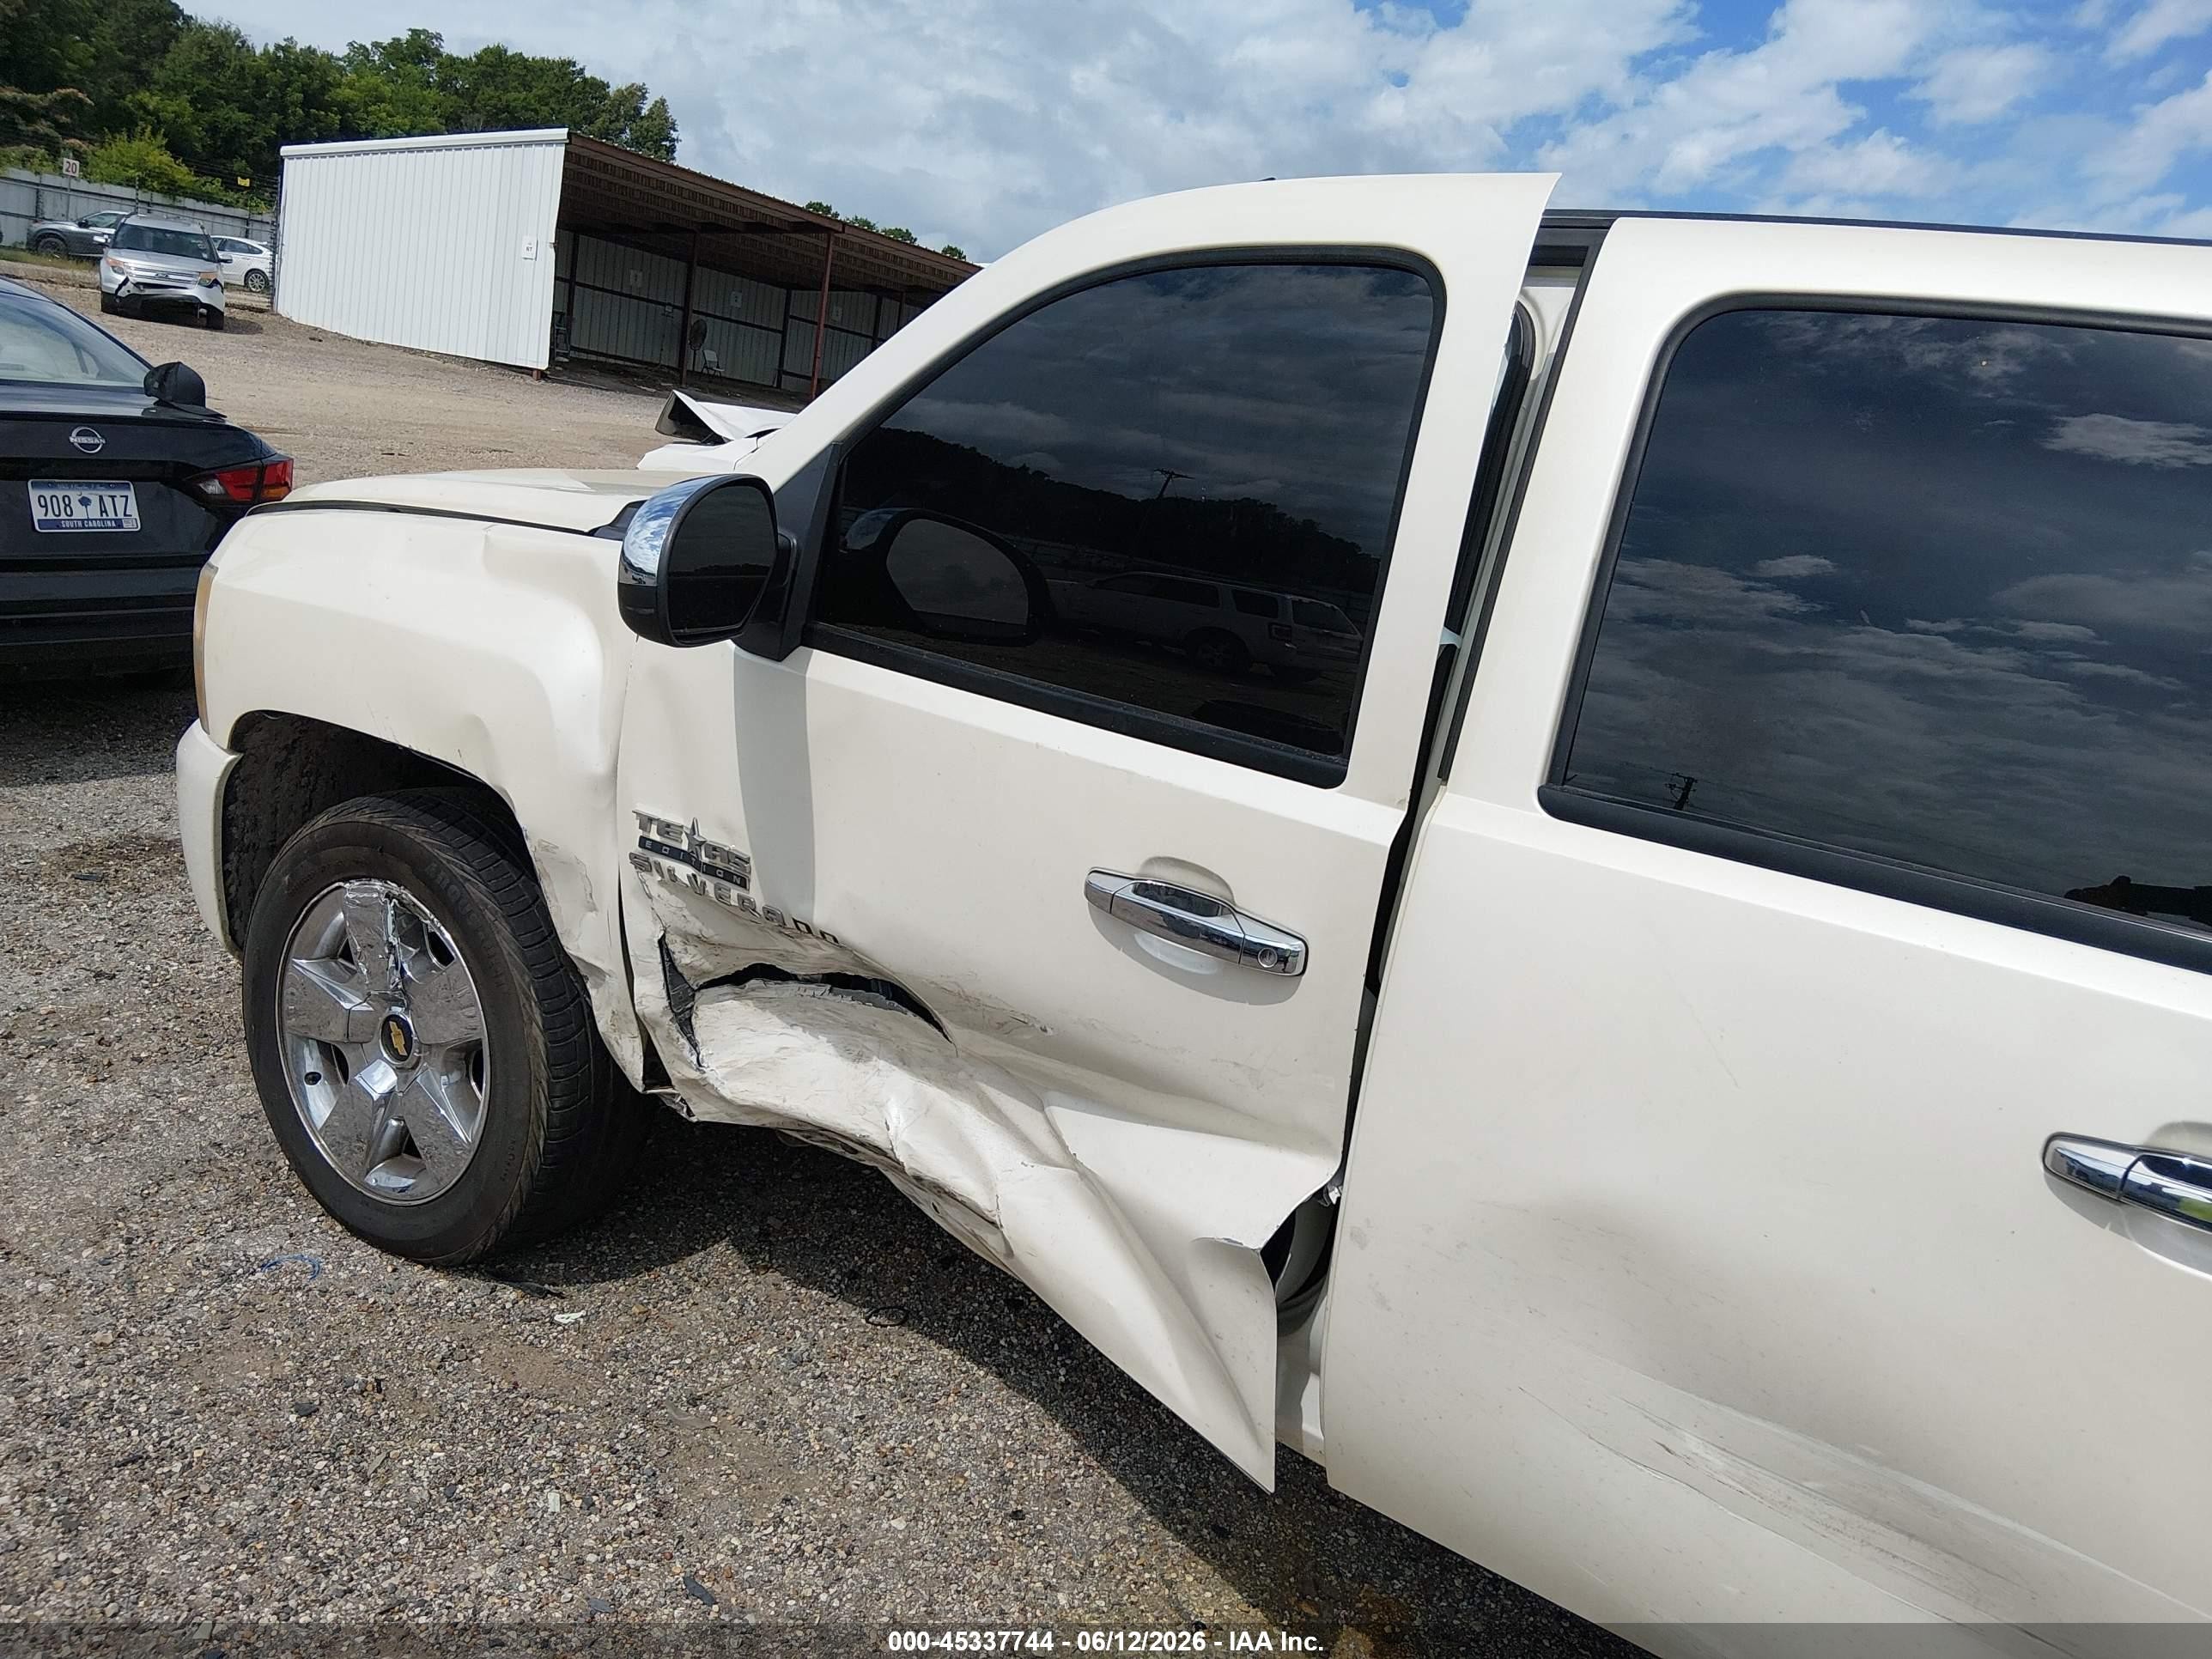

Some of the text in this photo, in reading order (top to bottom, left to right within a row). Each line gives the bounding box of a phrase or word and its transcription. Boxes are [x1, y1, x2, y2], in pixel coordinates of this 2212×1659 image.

[65, 161, 77, 173] 20
[69, 435, 106, 444] NISSAN
[37, 495, 132, 517] 908 ATZ
[61, 520, 83, 528] SOUTH
[84, 520, 117, 528] CAROLINA
[645, 839, 742, 885] EDITION
